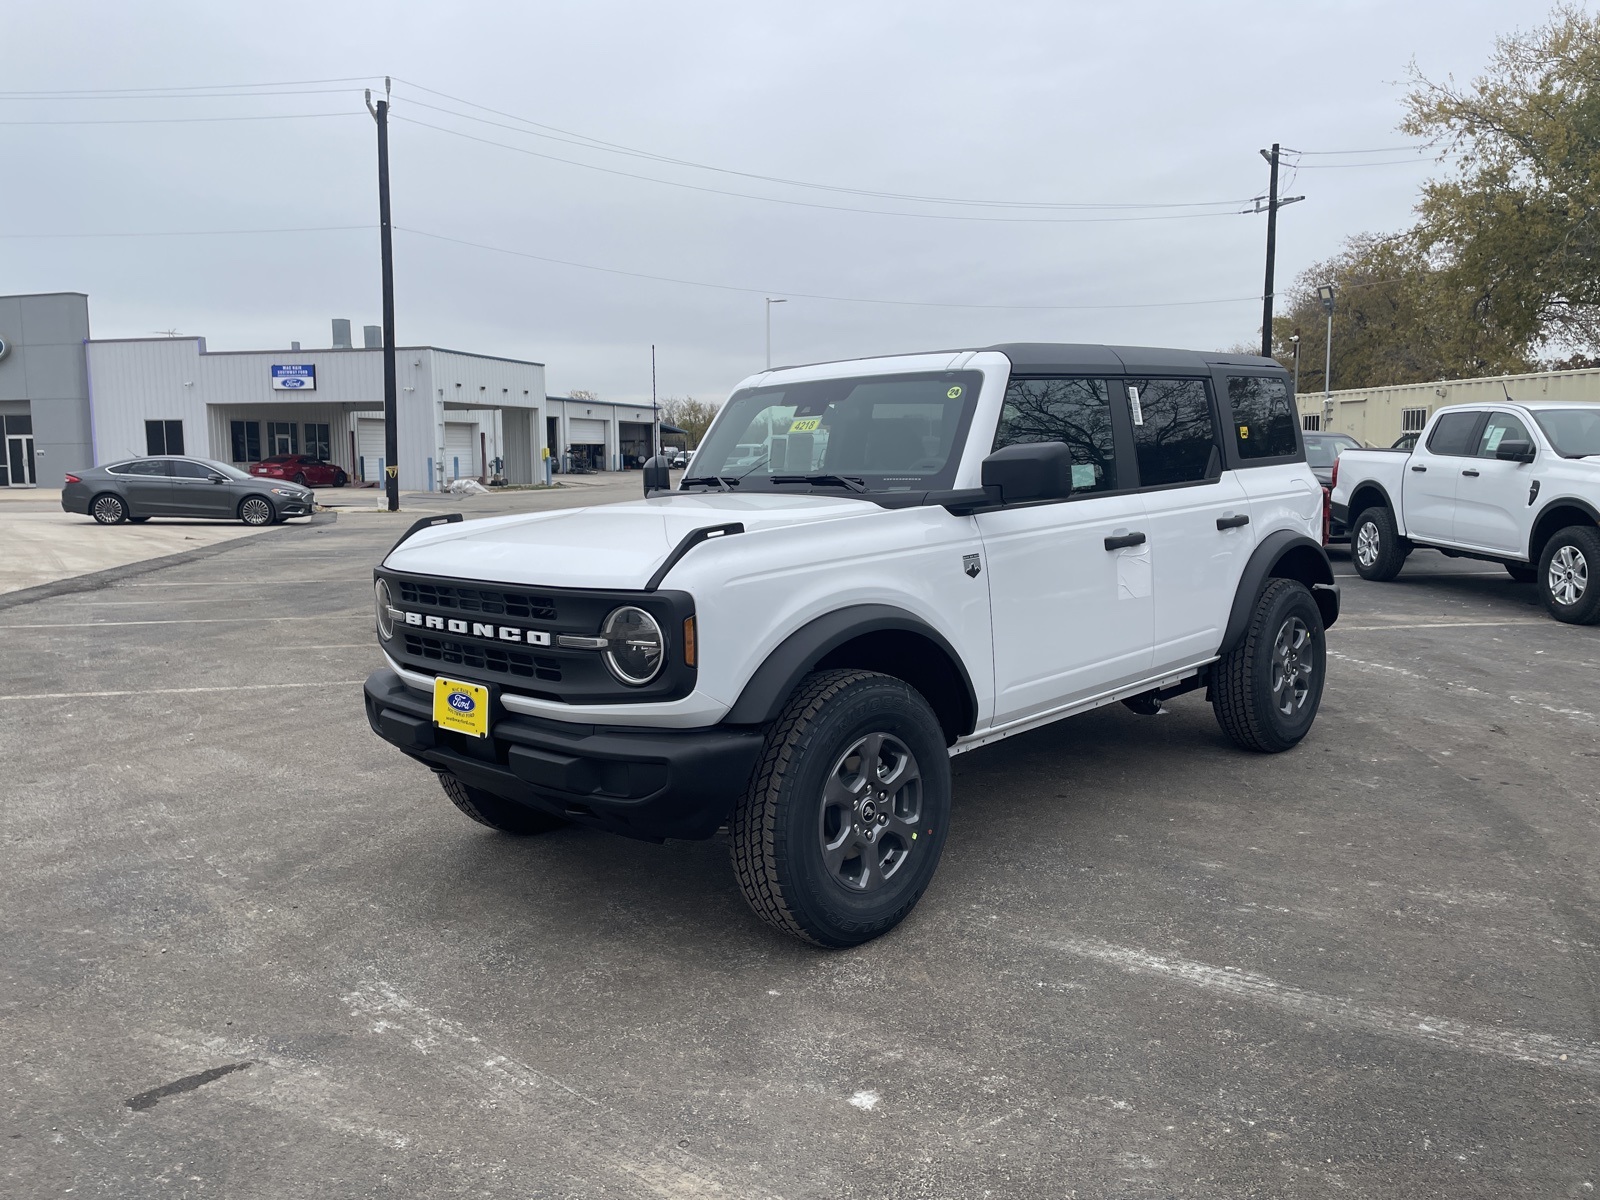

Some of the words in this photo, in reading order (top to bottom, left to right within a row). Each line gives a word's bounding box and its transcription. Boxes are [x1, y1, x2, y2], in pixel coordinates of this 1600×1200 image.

[285, 379, 301, 387] Ford
[949, 388, 960, 396] 24
[794, 420, 816, 430] 4218
[405, 611, 551, 646] BRONCO
[452, 694, 471, 710] Ford
